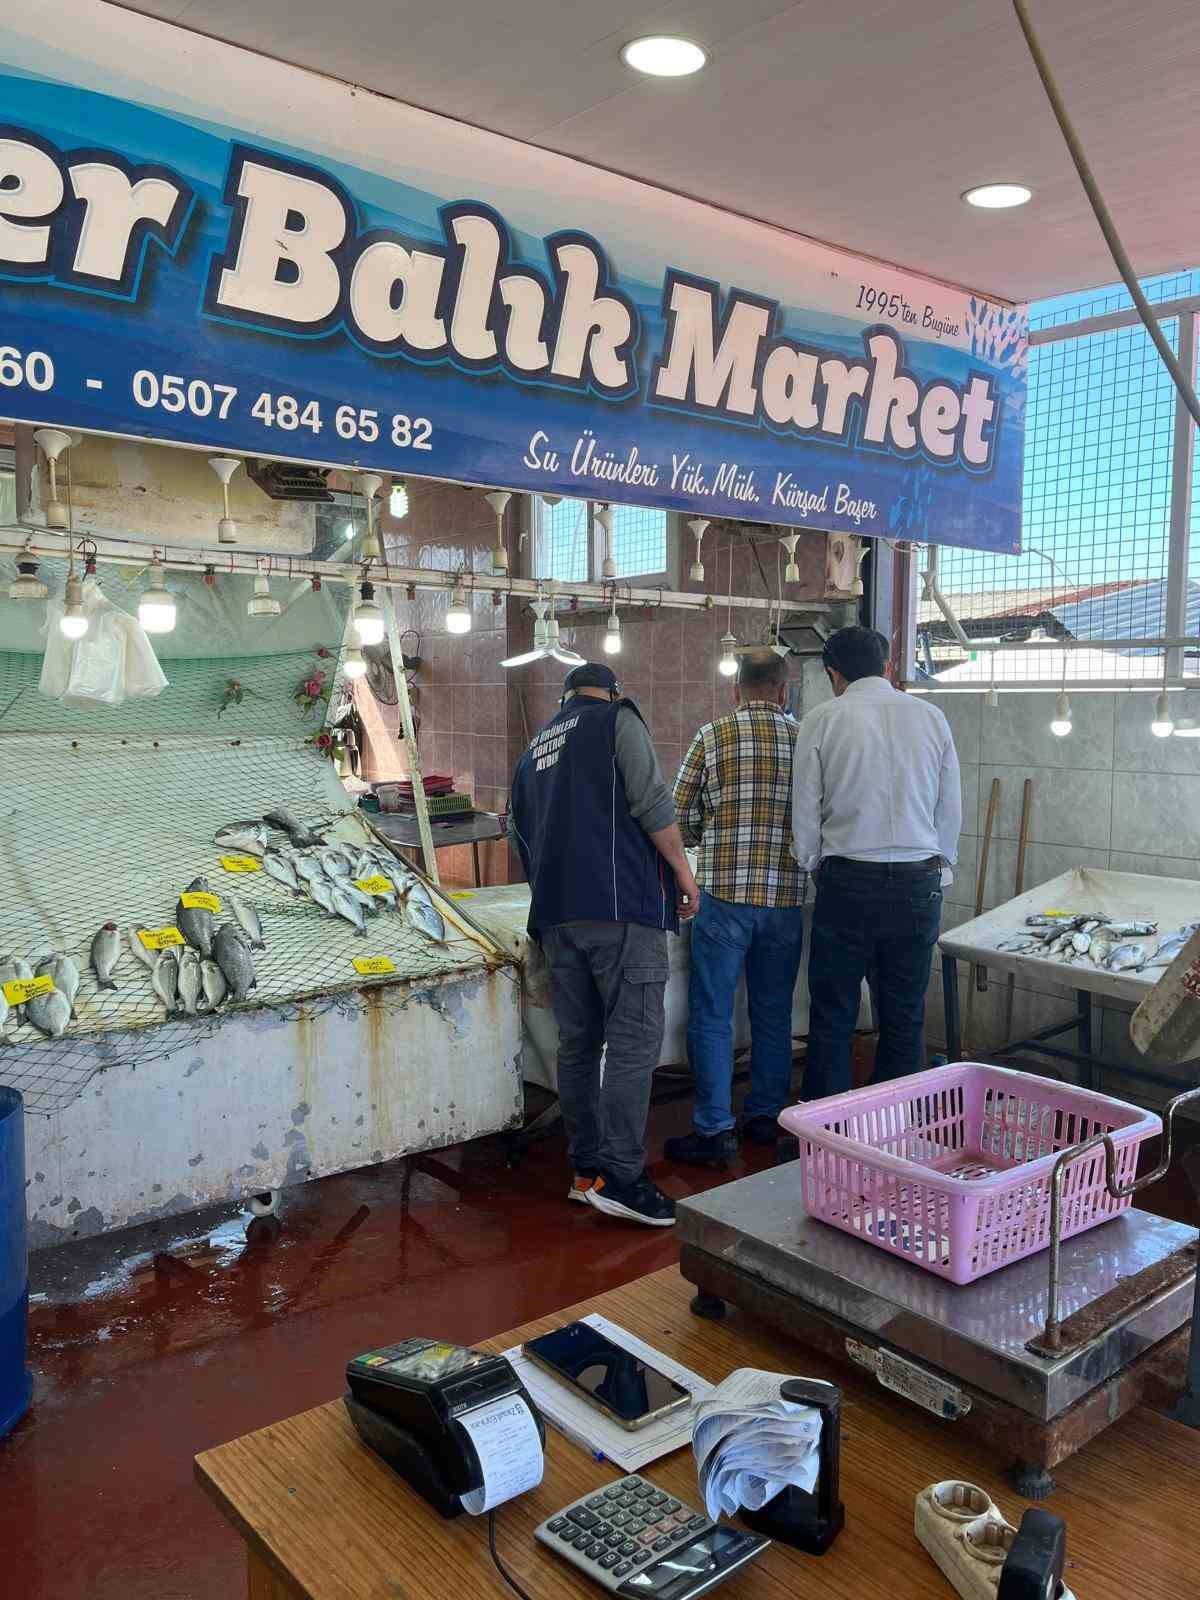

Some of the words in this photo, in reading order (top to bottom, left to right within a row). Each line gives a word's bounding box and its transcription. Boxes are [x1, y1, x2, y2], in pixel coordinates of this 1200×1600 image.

[217, 161, 631, 389] Balık
[656, 282, 994, 464] Market
[856, 285, 917, 325] 1995'ten
[922, 305, 960, 339] Bugüne
[0, 345, 54, 391] 60
[132, 369, 238, 420] 0507
[251, 392, 323, 434] 484
[335, 405, 379, 442] 65
[391, 414, 433, 451] 82
[523, 430, 560, 472] Su
[570, 429, 660, 487] Ürünleri
[772, 472, 829, 518] Kürşad
[834, 483, 879, 525] Başer
